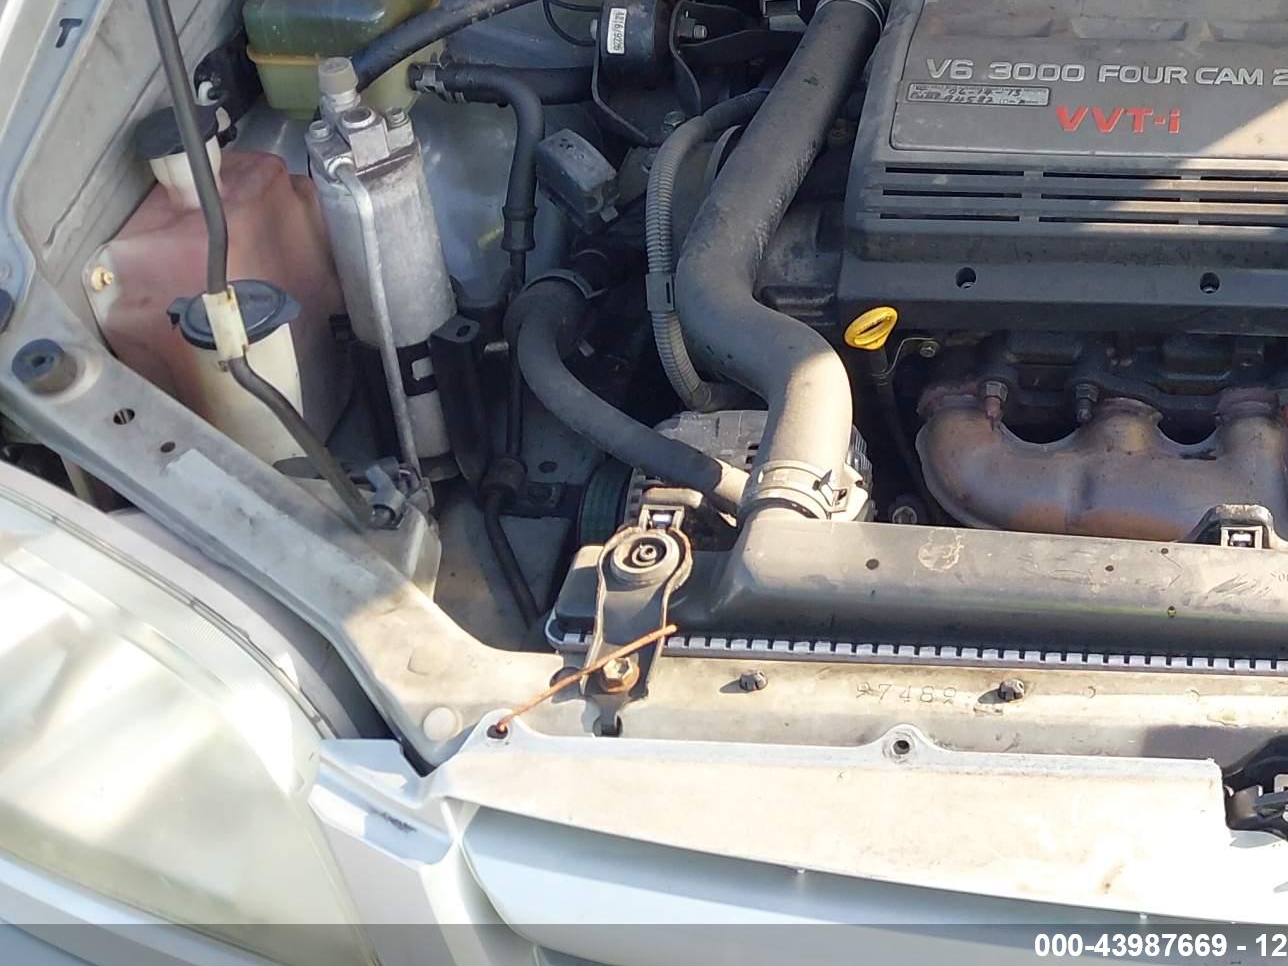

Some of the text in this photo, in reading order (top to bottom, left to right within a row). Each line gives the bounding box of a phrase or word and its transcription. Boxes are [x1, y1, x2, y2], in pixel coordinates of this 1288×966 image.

[926, 59, 974, 80] V6
[988, 62, 1085, 82] 3000
[1098, 65, 1188, 84] FOUR
[1195, 67, 1264, 85] CAM
[1056, 105, 1182, 133] VVT-i
